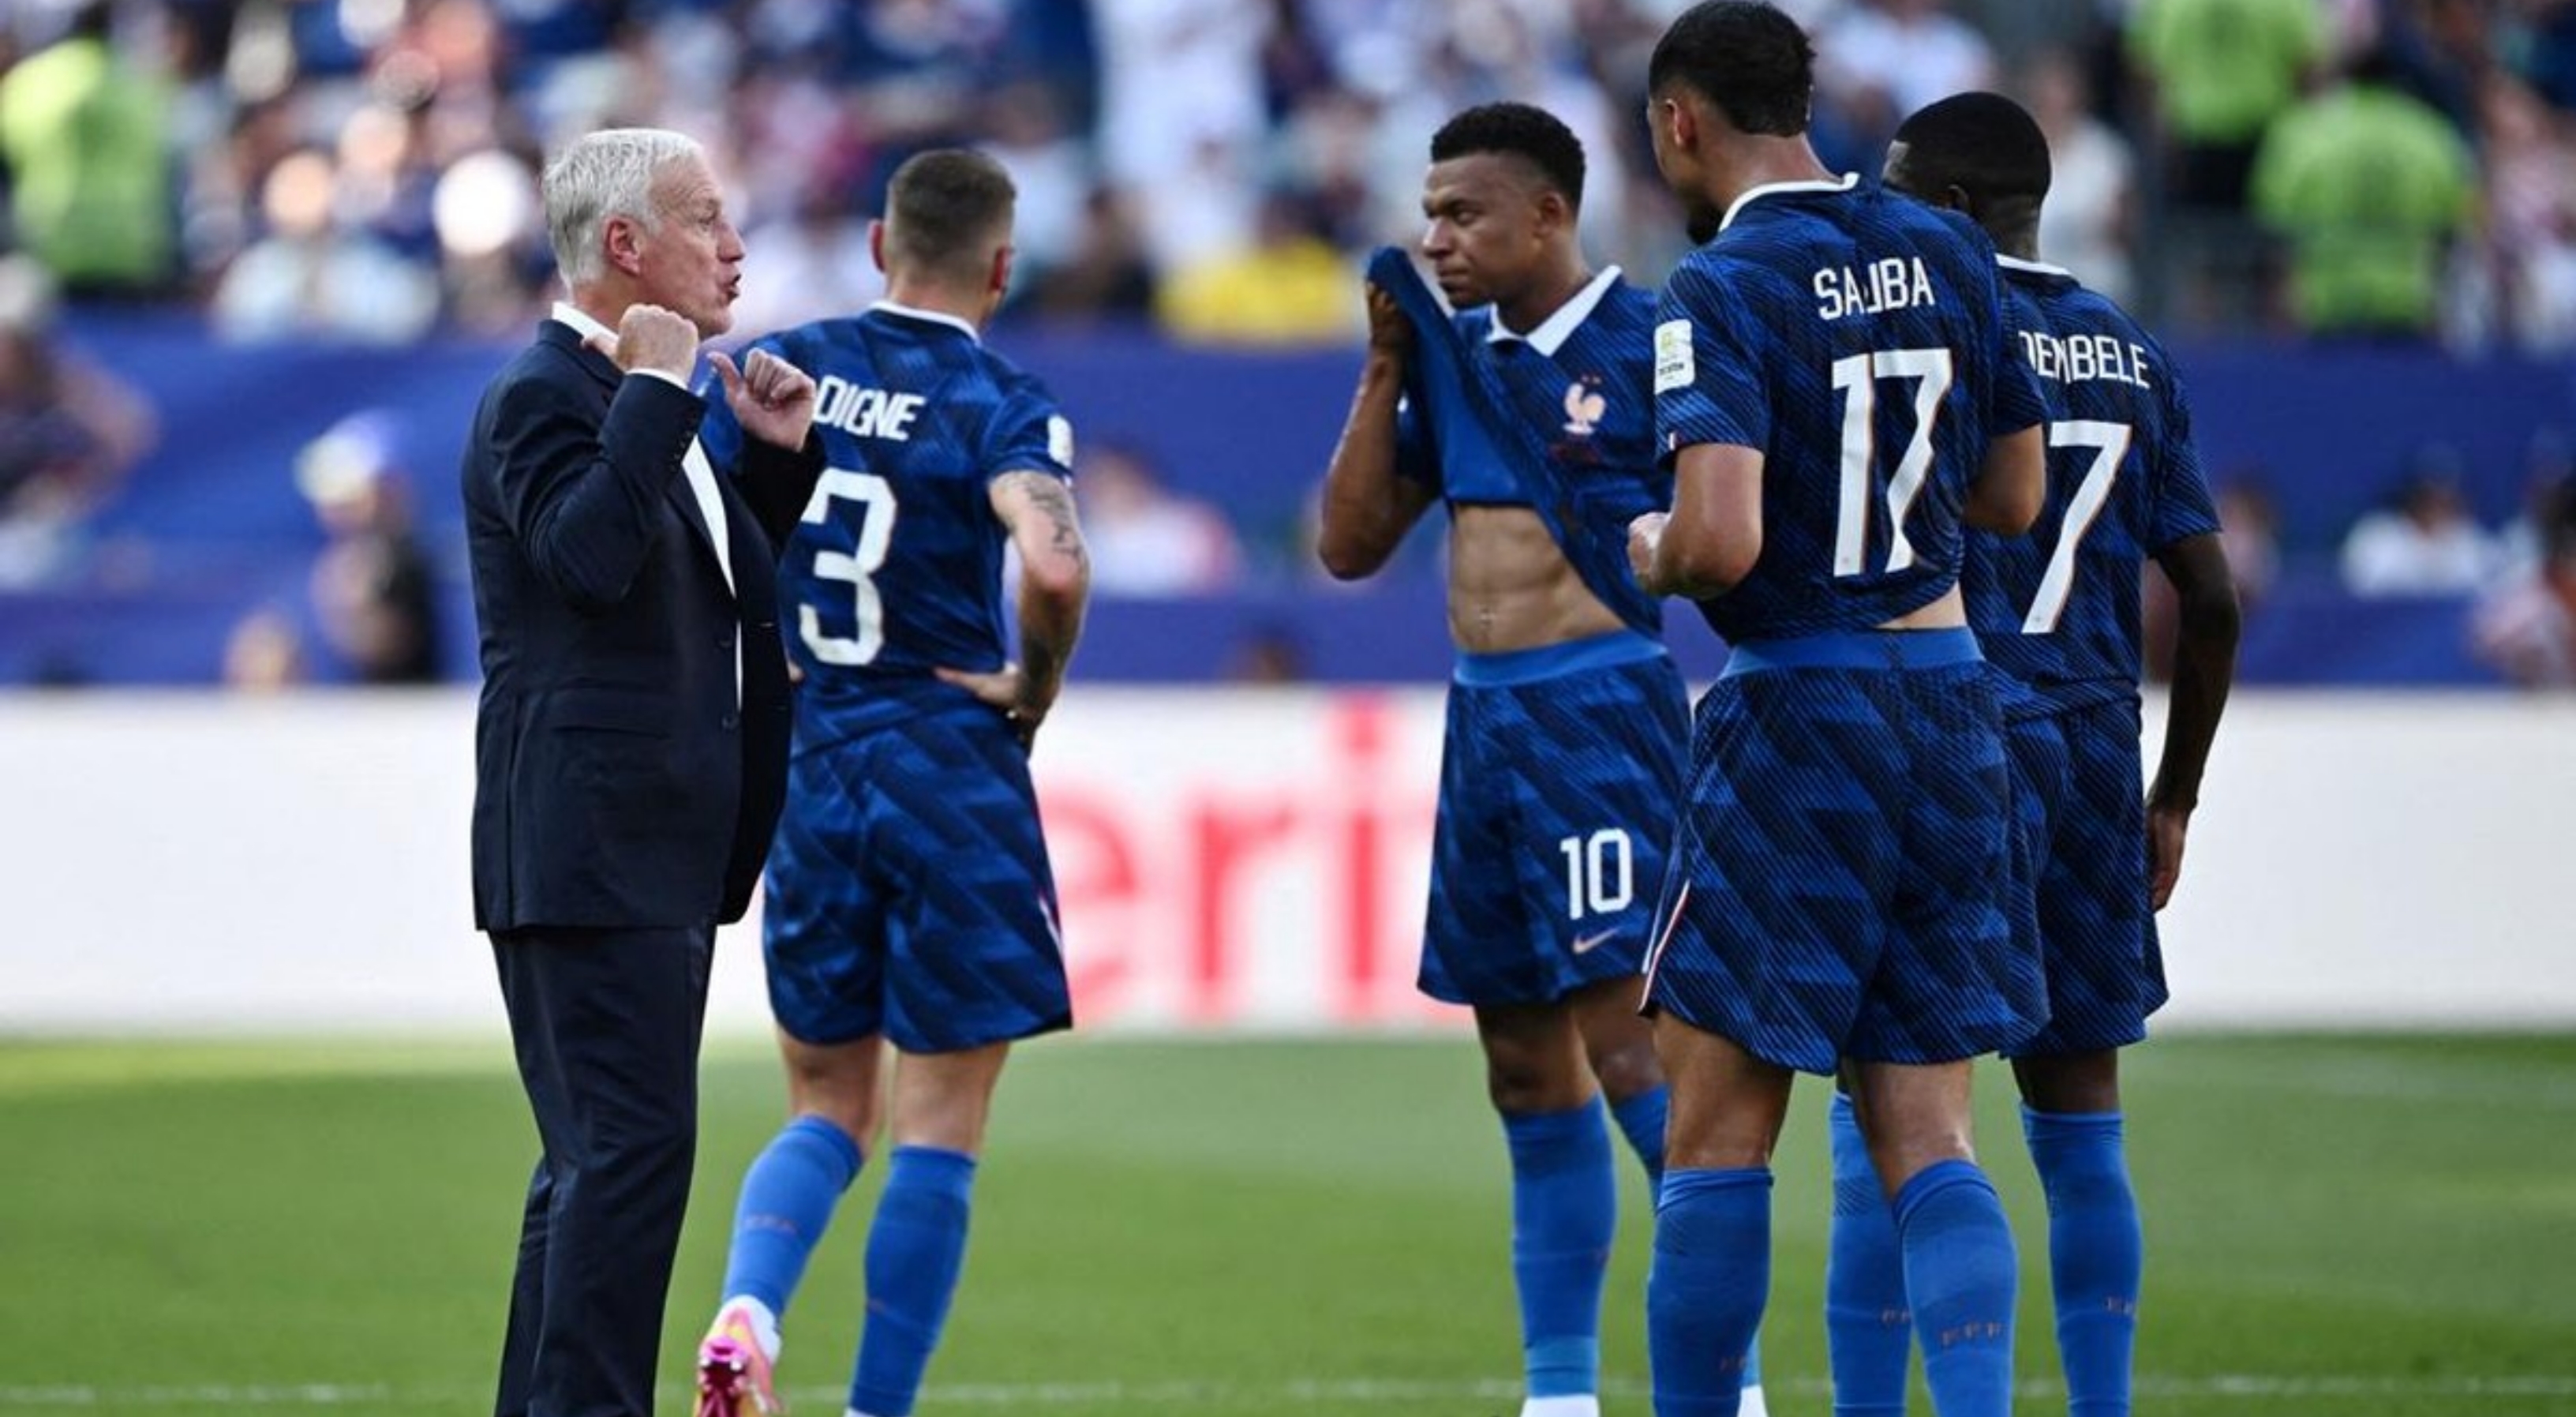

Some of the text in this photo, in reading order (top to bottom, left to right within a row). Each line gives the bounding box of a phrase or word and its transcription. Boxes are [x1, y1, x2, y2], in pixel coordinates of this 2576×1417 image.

[811, 374, 927, 441] DIGNE
[1831, 347, 1953, 577] 17
[798, 467, 897, 665] 3
[2021, 419, 2132, 634] 7
[1559, 827, 1634, 920] 10
